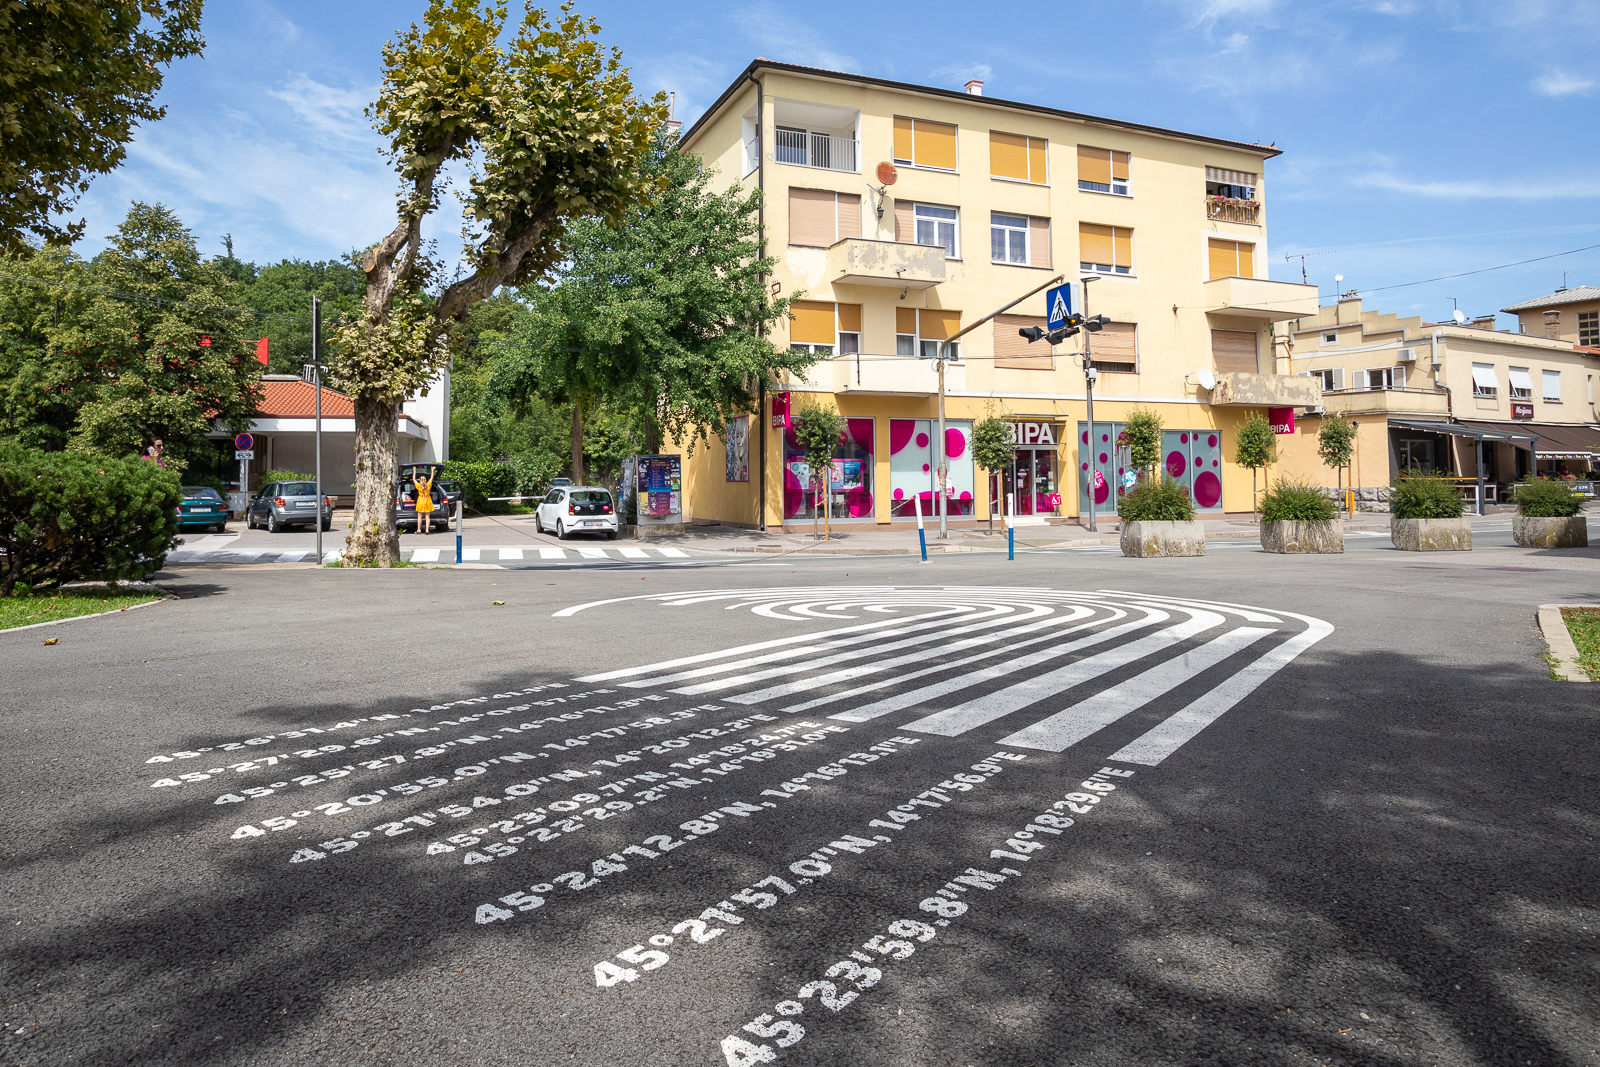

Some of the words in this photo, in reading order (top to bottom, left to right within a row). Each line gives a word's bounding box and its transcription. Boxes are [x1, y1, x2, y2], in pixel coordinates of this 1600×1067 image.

[772, 414, 786, 427] BIPA
[1001, 422, 1055, 445] BIPA
[1270, 423, 1291, 434] BIPA
